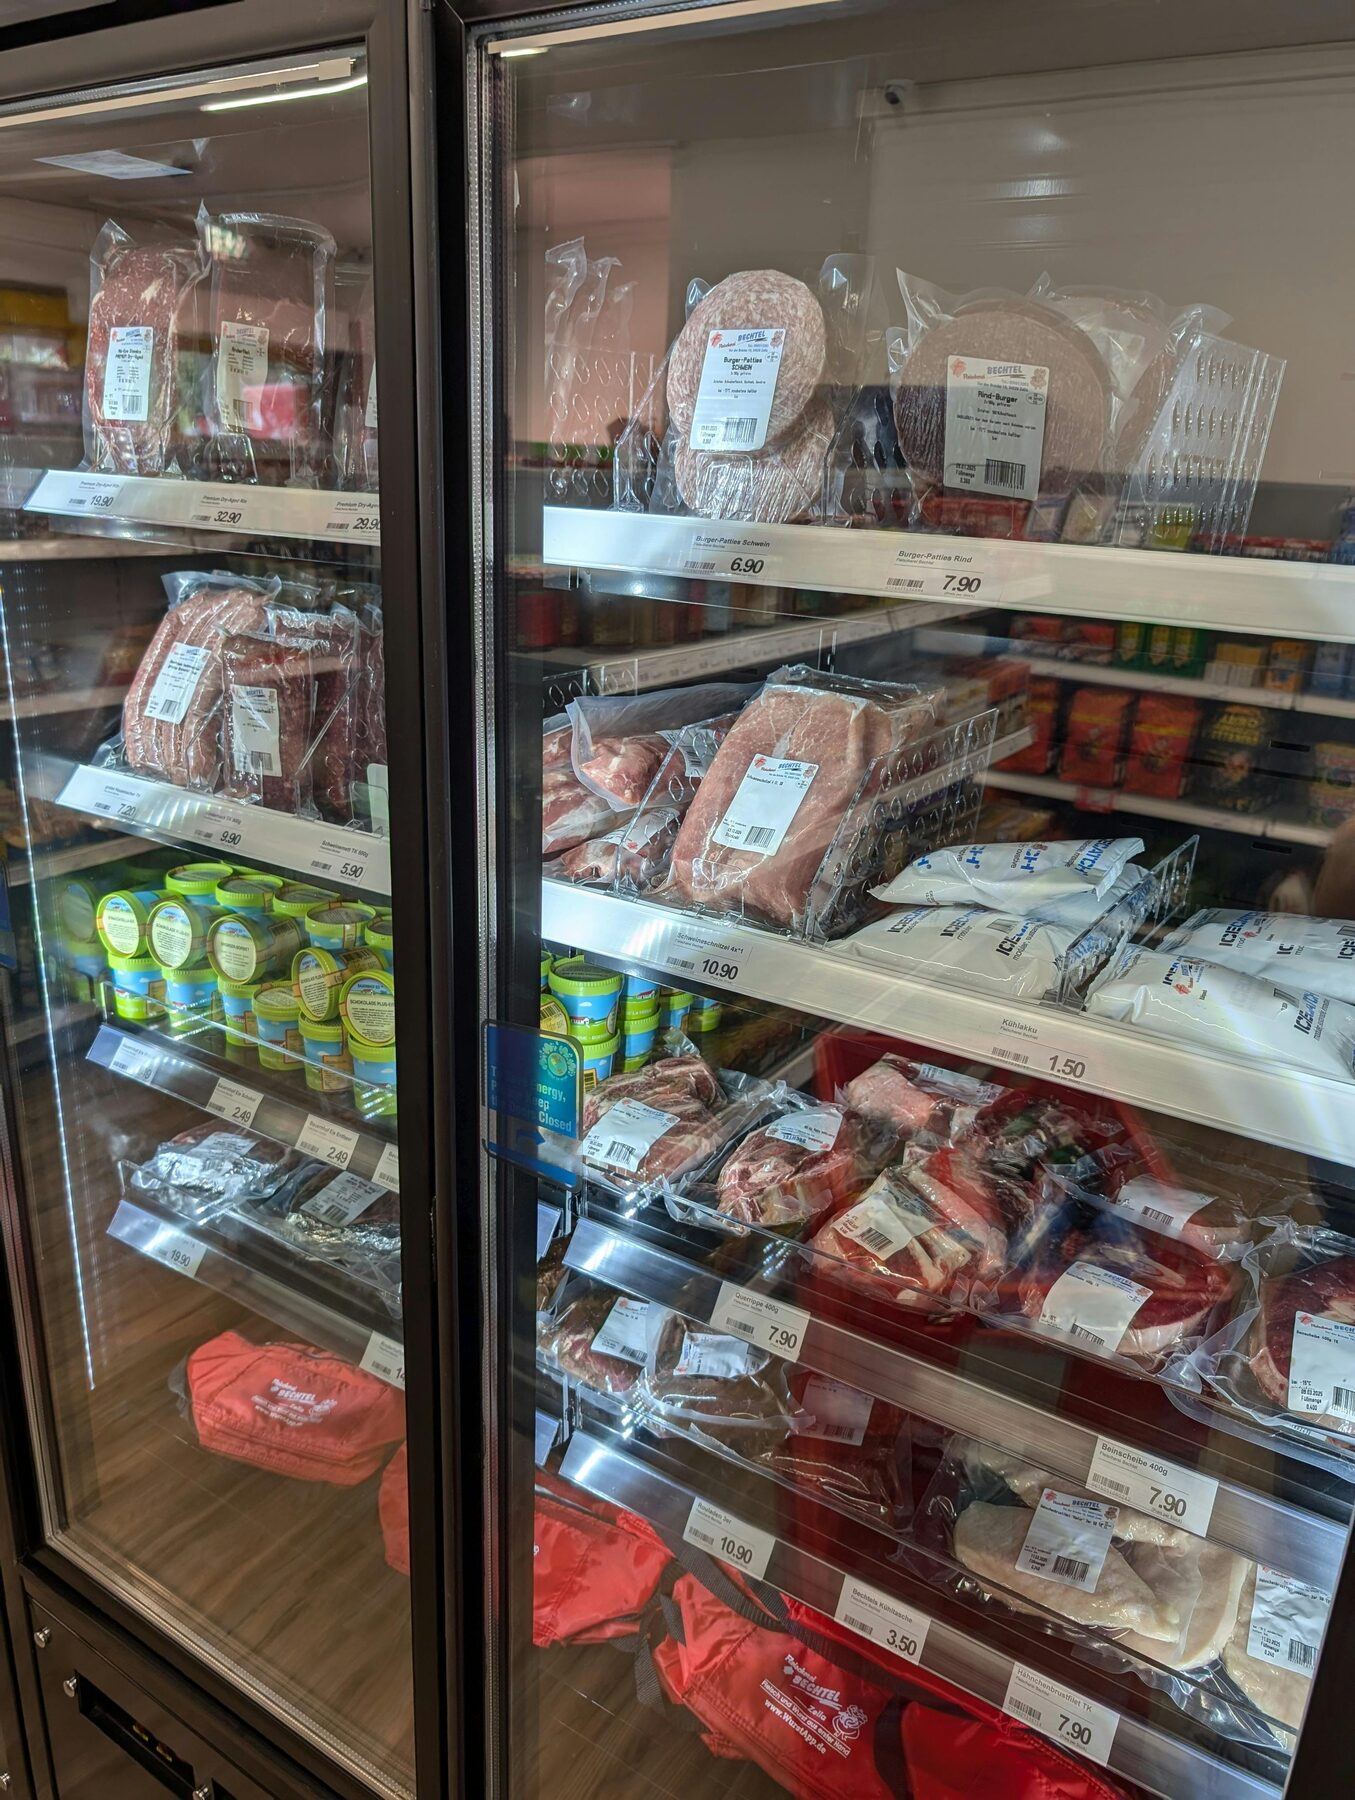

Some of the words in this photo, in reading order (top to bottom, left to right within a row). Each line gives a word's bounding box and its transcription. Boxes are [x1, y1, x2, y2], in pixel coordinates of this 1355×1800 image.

[737, 331, 766, 341] BECHTEL
[987, 365, 1022, 375] BECHTEL
[978, 391, 1018, 403] Rind-Burger
[90, 495, 114, 508] 19.90
[214, 510, 242, 524] 32.90
[696, 536, 741, 545] Burger-Patties
[742, 540, 770, 548] Schwein
[730, 557, 764, 574] 6.90
[898, 550, 952, 561] Burger-Patties
[954, 555, 973, 563] Rind
[943, 574, 981, 593] 7.90
[117, 803, 137, 817] 7.20
[220, 830, 242, 845] 9.90
[340, 862, 364, 878] 5.90
[677, 932, 730, 951] Schweineschnitzel
[702, 958, 739, 980] 10.90
[1002, 1018, 1038, 1034] Kühlakku
[1048, 1055, 1086, 1078] 1.50
[536, 1083, 566, 1103] nergy,
[232, 1106, 251, 1123] 2.49
[538, 1110, 572, 1132] Closed
[326, 1146, 349, 1164] 2.49
[170, 1248, 191, 1267] 19.90
[764, 1303, 779, 1314] 400g
[768, 1325, 798, 1349] 7.90
[1333, 1324, 1355, 1334] BECH
[1301, 1396, 1322, 1404] Füllmenge
[1101, 1443, 1148, 1467] Beinscheibe
[1149, 1463, 1168, 1476] 400g
[697, 1502, 723, 1519] Rouladen
[1072, 1500, 1100, 1509] BECHTEL
[1149, 1486, 1187, 1517] 7.90
[720, 1536, 753, 1564] 10.90
[852, 1587, 878, 1606] Bechtels
[879, 1602, 913, 1624] Kühltasche
[886, 1629, 918, 1656] 3.50
[792, 1675, 840, 1702] BECHTEL
[1017, 1668, 1081, 1707] Hähnchenbrustfilet
[1082, 1701, 1093, 1713] TK
[761, 1679, 781, 1701] Fleisch
[780, 1696, 792, 1708] und
[791, 1704, 807, 1722] Wurst
[806, 1718, 818, 1730] aus
[817, 1726, 834, 1744] erster
[833, 1740, 851, 1757] Hand
[806, 1704, 827, 1722] Zella
[764, 1699, 826, 1755] www.WurstApp.de
[1058, 1714, 1092, 1745] 7.90
